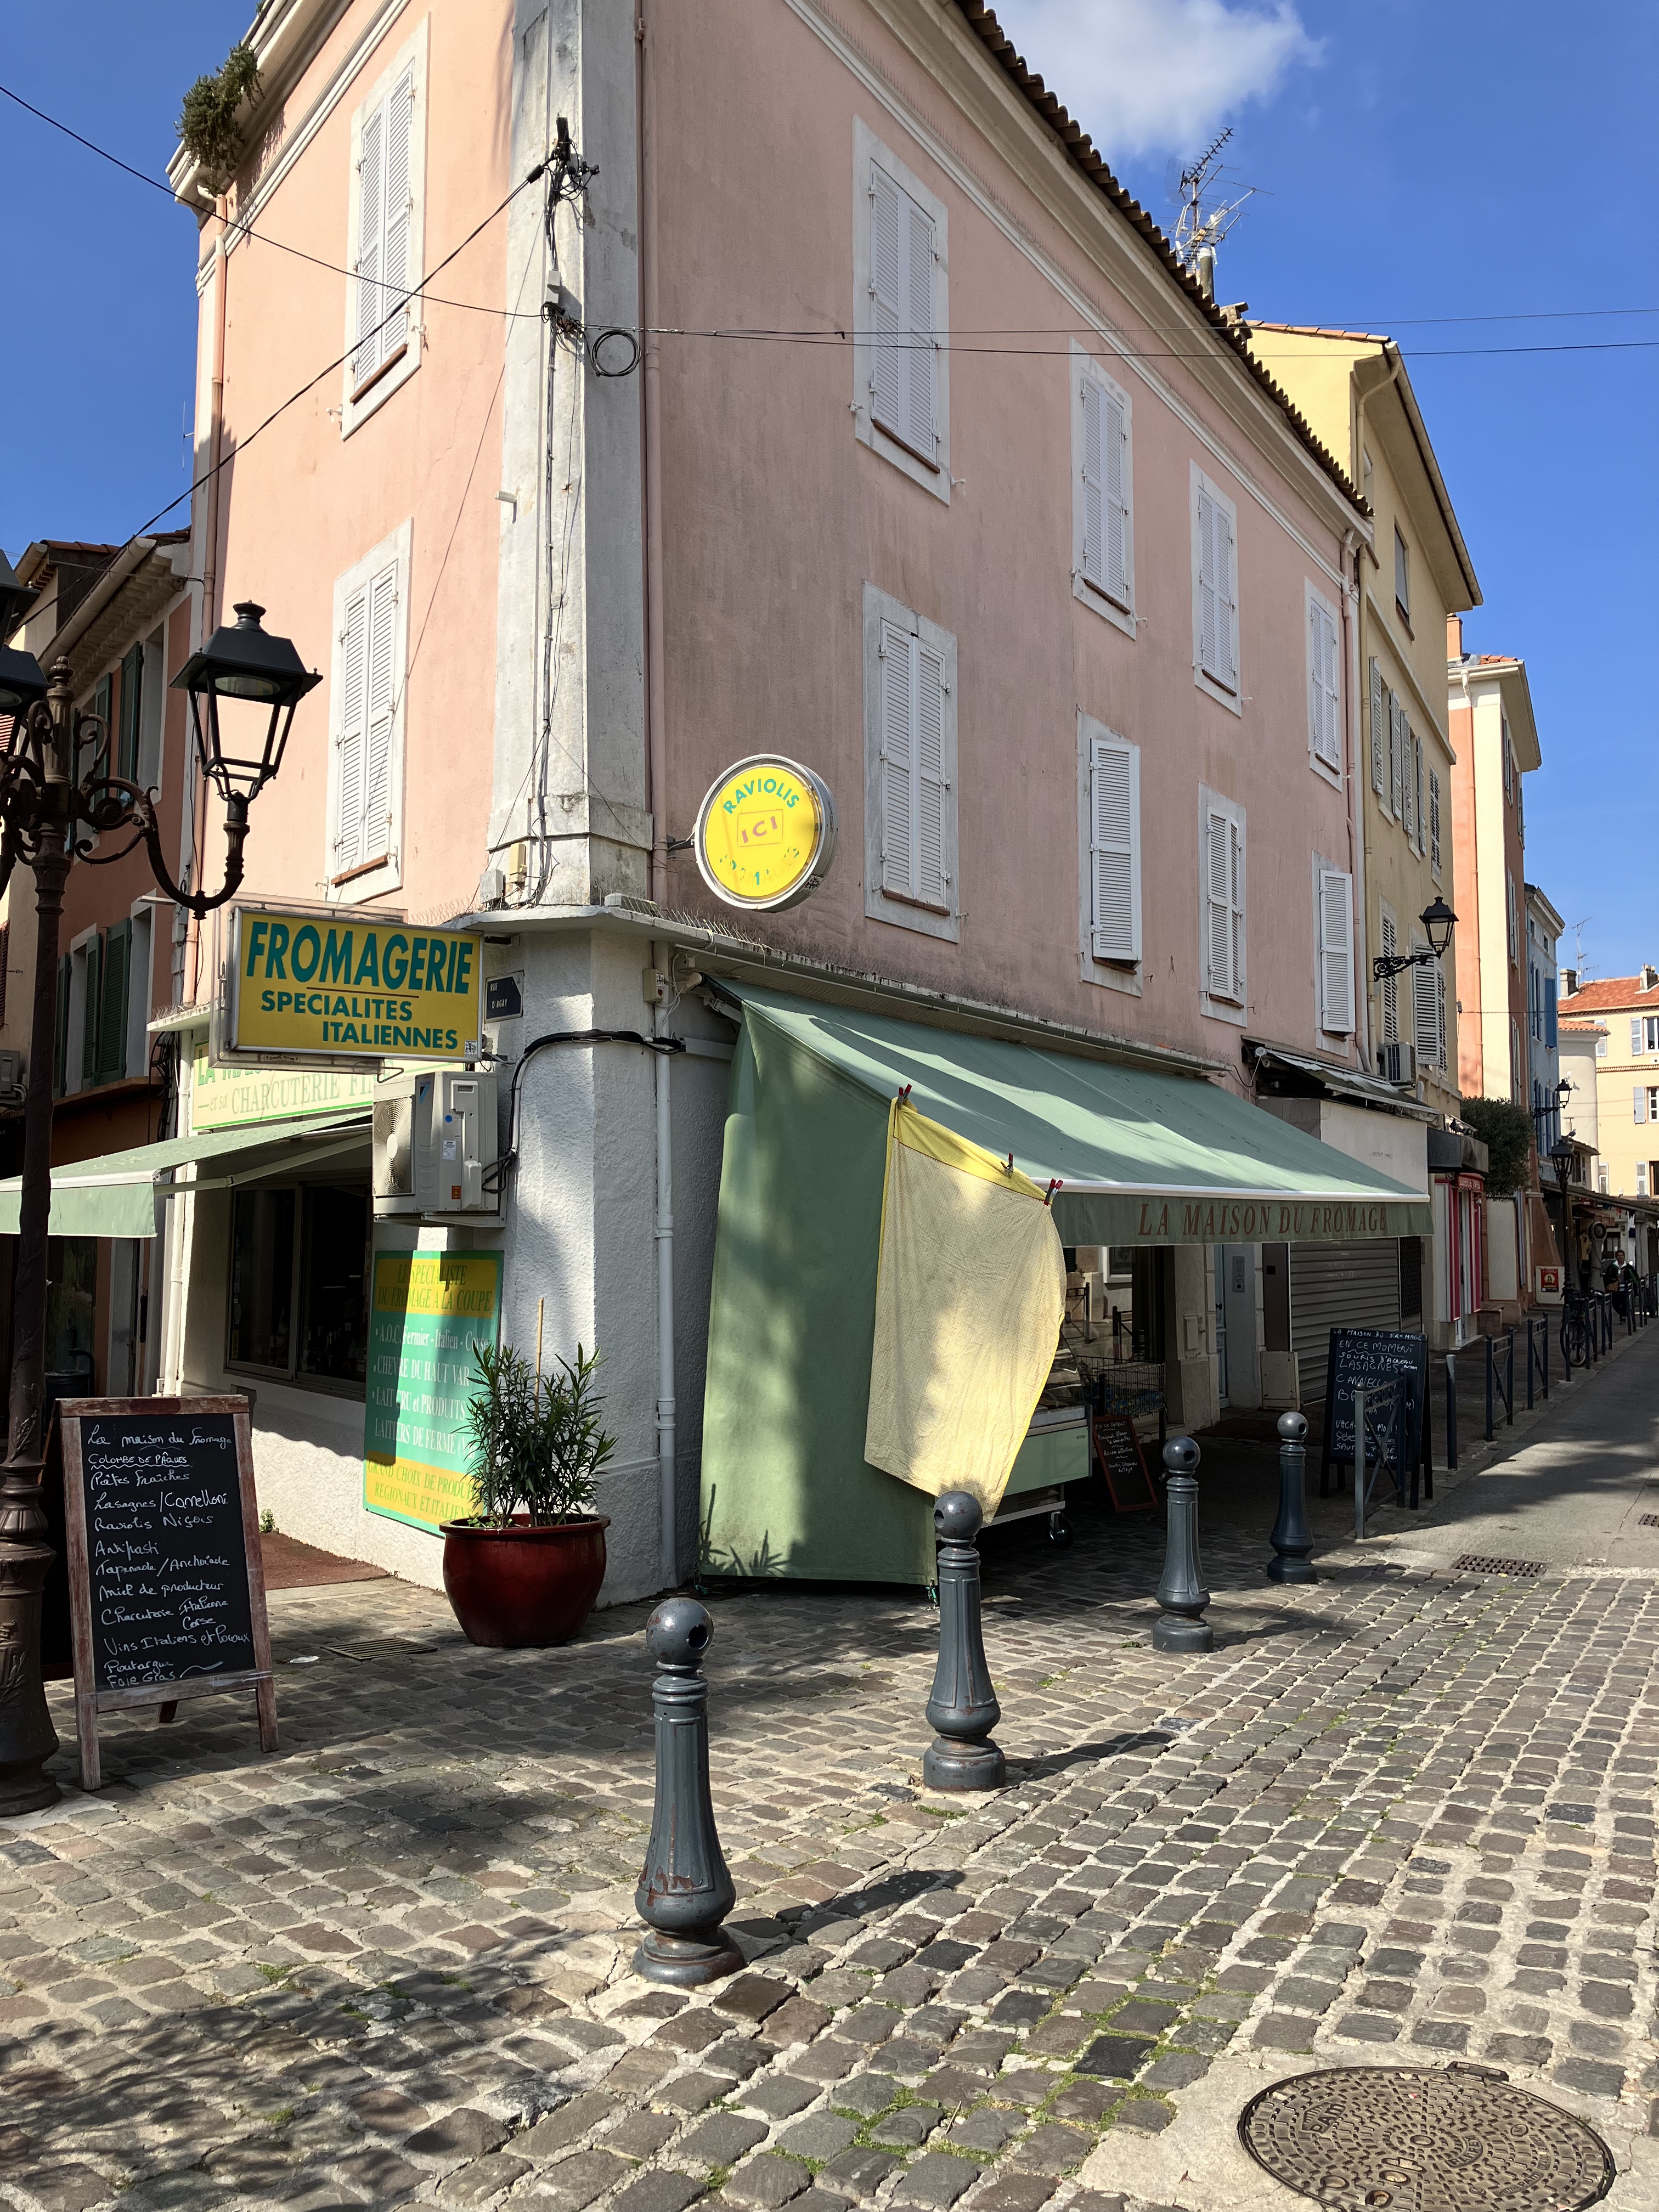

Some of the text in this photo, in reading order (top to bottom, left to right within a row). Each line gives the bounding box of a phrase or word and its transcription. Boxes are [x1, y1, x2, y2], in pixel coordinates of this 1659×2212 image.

[723, 778, 799, 814] RAVIOLIS
[742, 816, 777, 844] ICI
[246, 921, 473, 995] FROMAGERIE
[261, 990, 413, 1022] SPECIALITES
[492, 998, 507, 1009] D'AGAY
[323, 1021, 458, 1049] ITALIENNES
[210, 1095, 218, 1111] et
[219, 1094, 228, 1110] sa
[232, 1073, 340, 1115] CHARCUTERIE
[1138, 1203, 1387, 1236] LA MAISON DU FROMAGE
[397, 1263, 467, 1285] LE SPECIALISTE
[377, 1286, 492, 1312] DU FROMAGE A LA COUPE
[403, 1325, 430, 1347] Fermier
[435, 1328, 459, 1350] Italien
[465, 1330, 489, 1352] Corse
[1347, 1329, 1372, 1337] MAISON
[1339, 1339, 1415, 1353] EN CE MOMENT
[1339, 1352, 1374, 1363] SOURIS
[1339, 1358, 1400, 1374] LASAGNES
[377, 1355, 470, 1387] CHEVRE DU HAUT VAR
[376, 1386, 466, 1421] LAIT CRU et PRODUITS
[168, 1431, 185, 1443] du
[375, 1417, 410, 1445] LAITIERS
[413, 1425, 424, 1447] DE
[426, 1428, 456, 1455] FERME
[137, 1455, 153, 1464] DE
[91, 1471, 130, 1491] Pâtes
[368, 1458, 394, 1479] GRAND
[396, 1465, 422, 1487] CHOIX
[424, 1472, 436, 1491] DE
[374, 1482, 419, 1510] REGIONAUX
[420, 1496, 431, 1512] ET
[94, 1516, 153, 1532] Raviolis
[95, 1540, 159, 1561] Antipasti
[139, 1583, 158, 1595] de
[161, 1579, 224, 1598] producteur
[101, 1606, 174, 1626] Charcuterie
[182, 1616, 217, 1631] Corse
[104, 1637, 138, 1656] Vins
[140, 1634, 198, 1650] Italiens
[104, 1660, 174, 1674] Poutargue
[106, 1671, 176, 1689] Foie Gras
